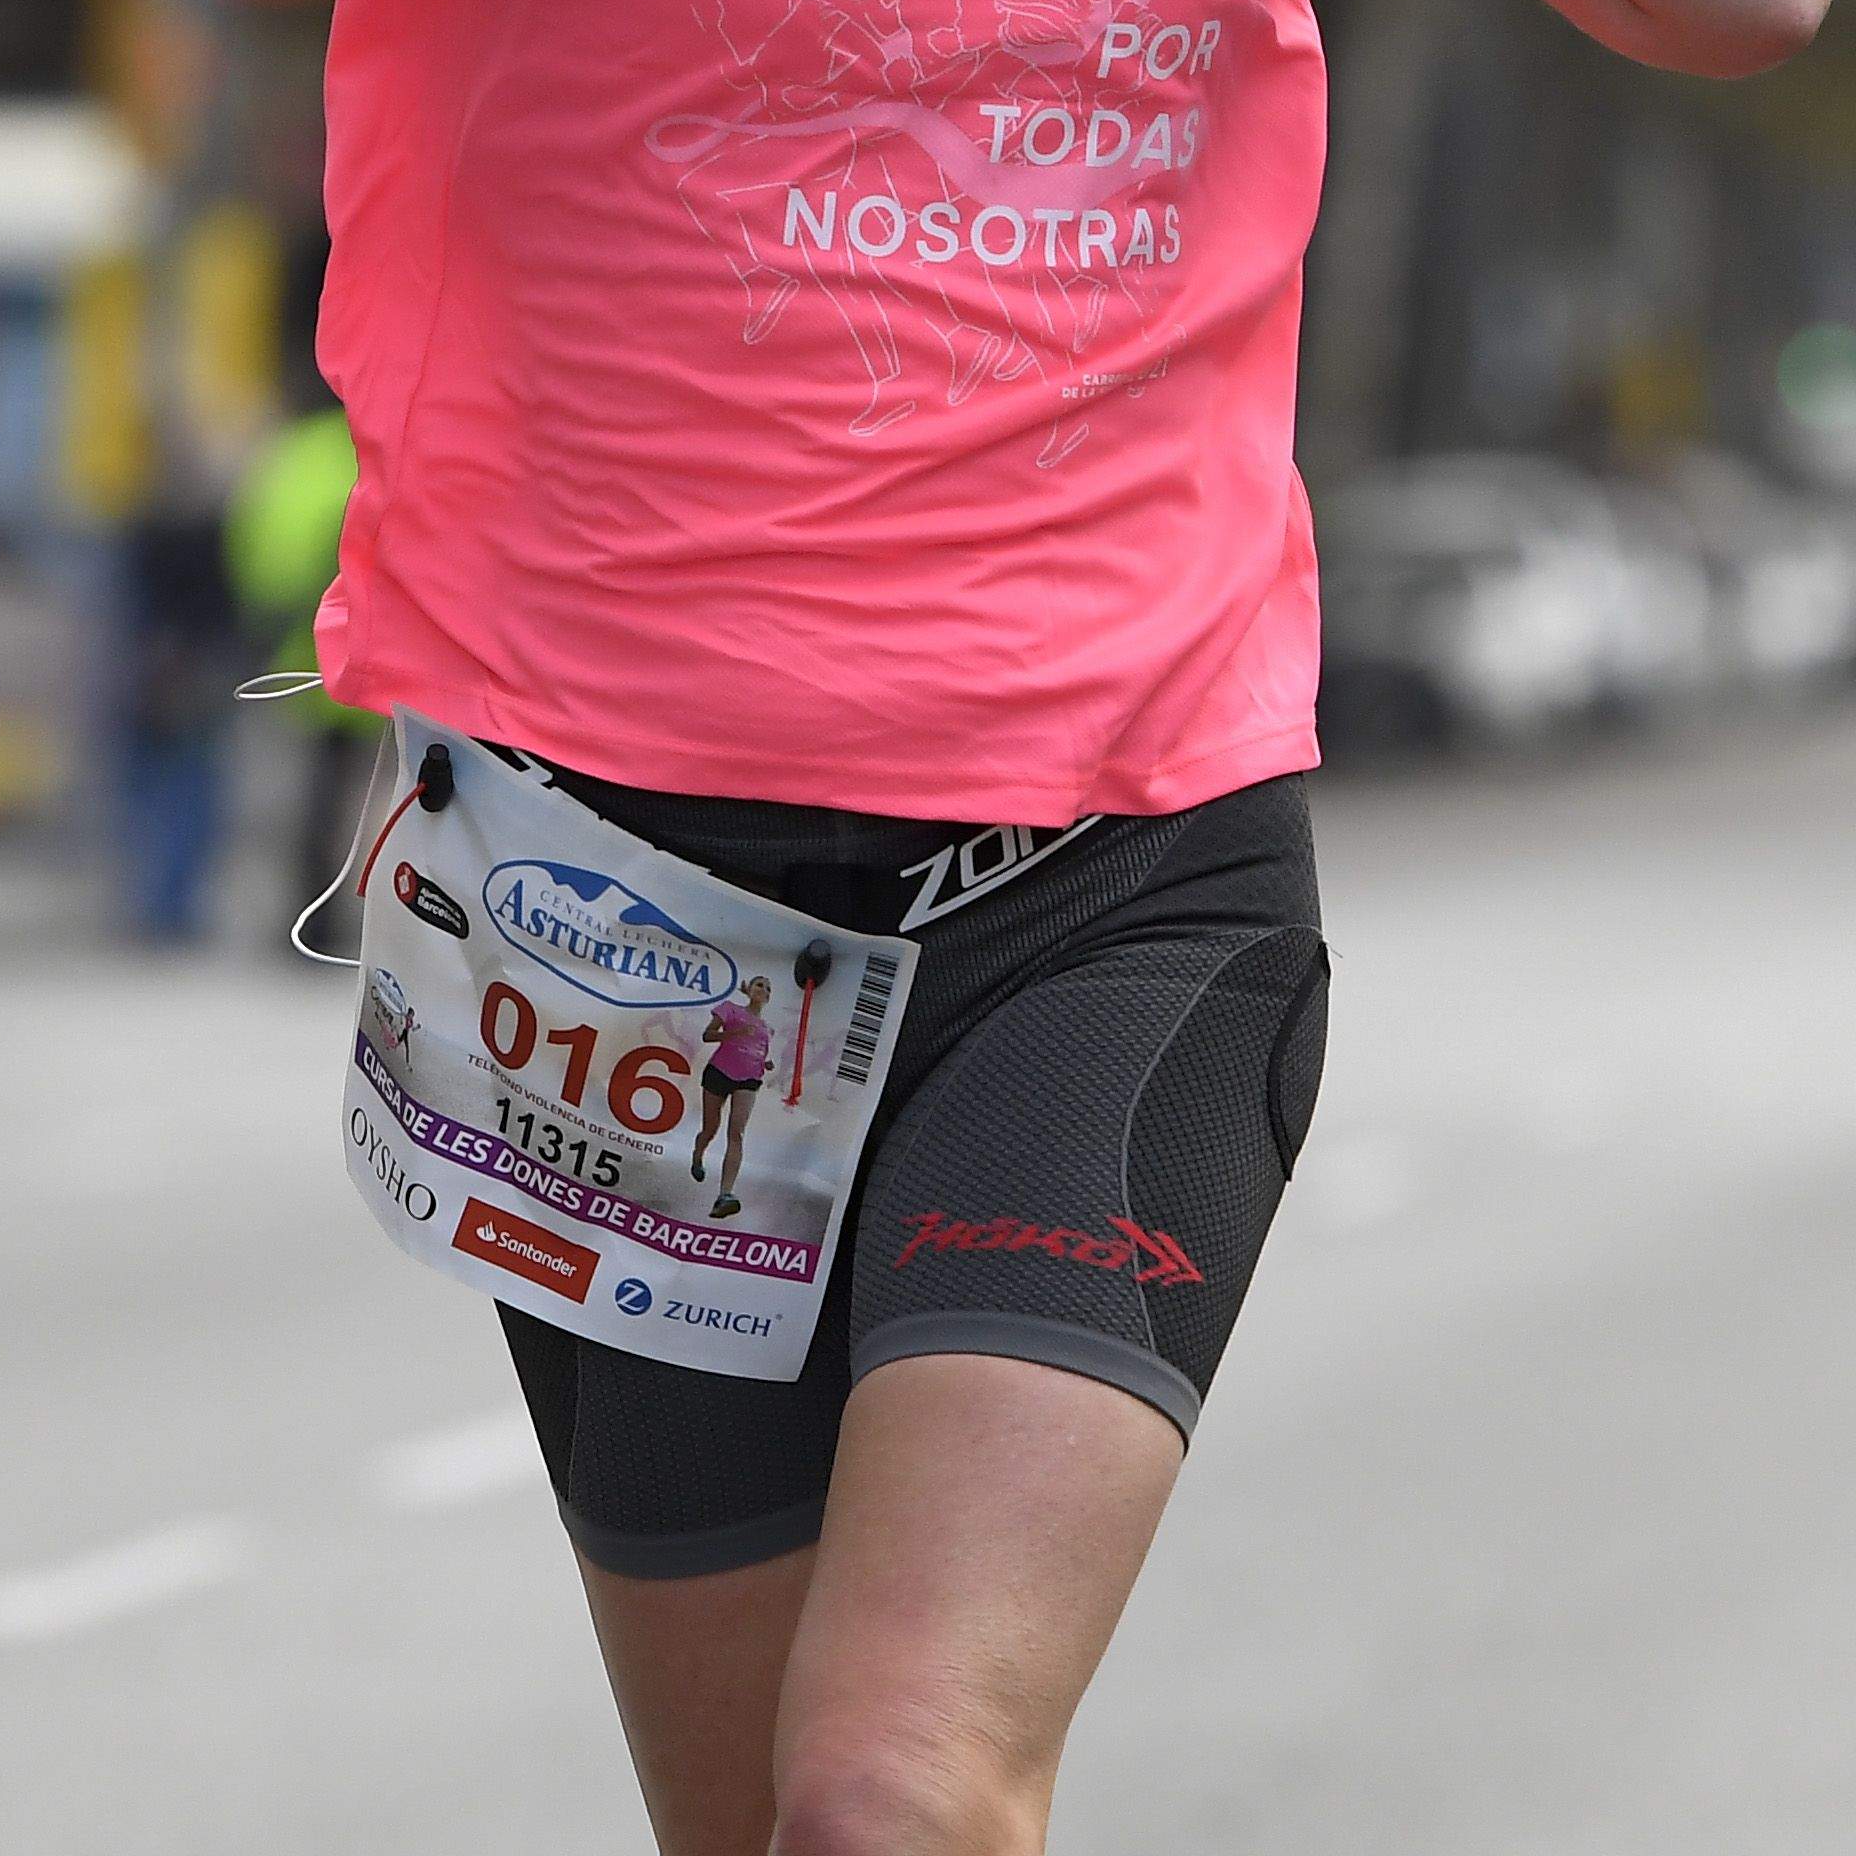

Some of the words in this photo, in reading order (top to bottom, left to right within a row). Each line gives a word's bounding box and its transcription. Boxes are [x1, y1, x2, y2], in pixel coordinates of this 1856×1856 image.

[1096, 19, 1221, 81] POR
[979, 103, 1200, 170] TODAS
[782, 187, 1182, 269] NOSOTRAS
[494, 878, 712, 996] ASTURIANA
[539, 889, 614, 937] CENTRAL
[622, 929, 711, 961] LECHERA
[480, 981, 692, 1135] 016
[362, 1046, 401, 1117] CURSA
[402, 1102, 435, 1140] DE
[431, 1123, 494, 1164] LES
[493, 1147, 584, 1211] DONES
[586, 1196, 631, 1228] DE
[632, 1211, 808, 1276] BARCELONA
[496, 1096, 623, 1188] 11315
[523, 1089, 586, 1129] VIOLENCIA
[588, 1123, 606, 1139] DE
[607, 1131, 665, 1156] GÉNERO
[350, 1107, 437, 1222] OYSHO
[497, 1230, 578, 1279] Santander
[663, 1299, 772, 1338] ZURICH
